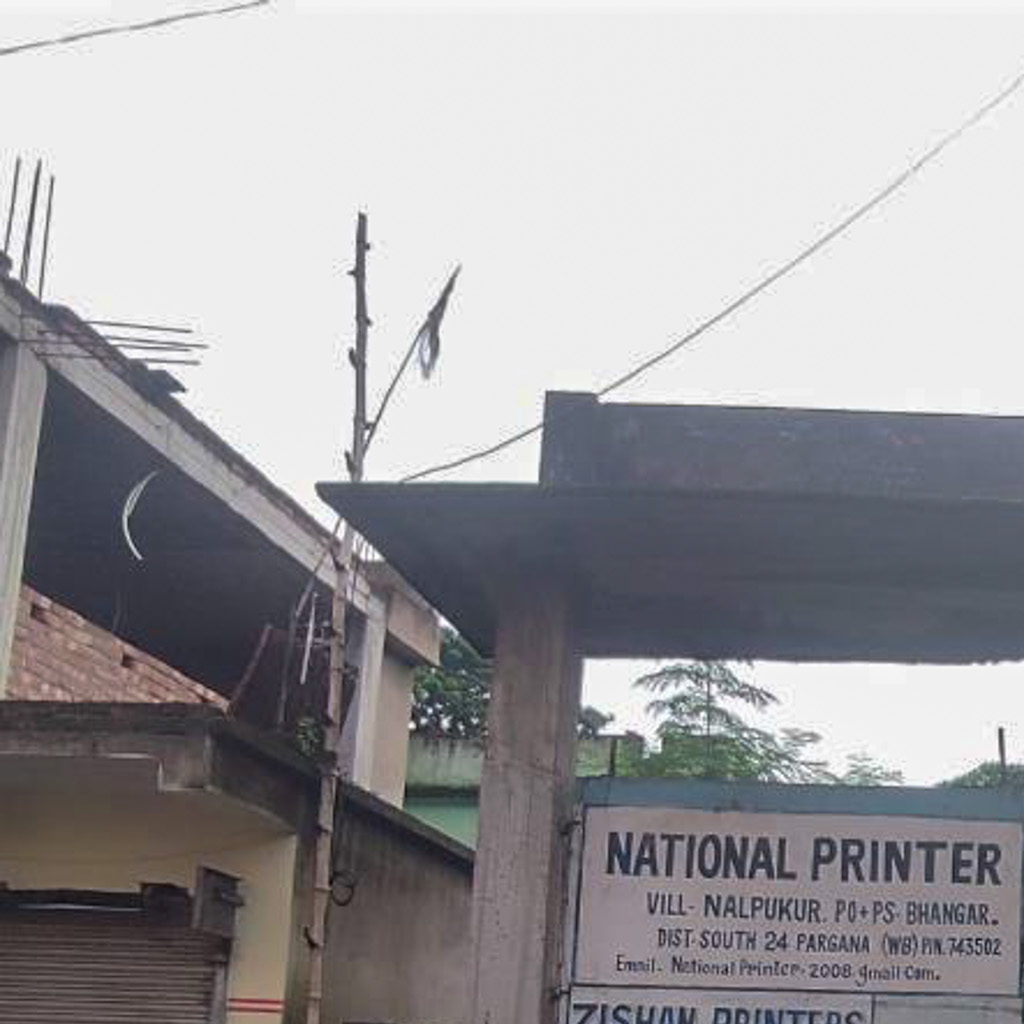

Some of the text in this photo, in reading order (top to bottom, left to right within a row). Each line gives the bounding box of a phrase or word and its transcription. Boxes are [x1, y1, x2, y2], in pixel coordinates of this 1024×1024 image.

[605, 831, 1002, 886] NATIONAL PRINTER
[700, 930, 757, 951] SOUTH
[765, 931, 787, 950] 24
[796, 933, 870, 954] PARGANA
[883, 934, 918, 957] (WB)
